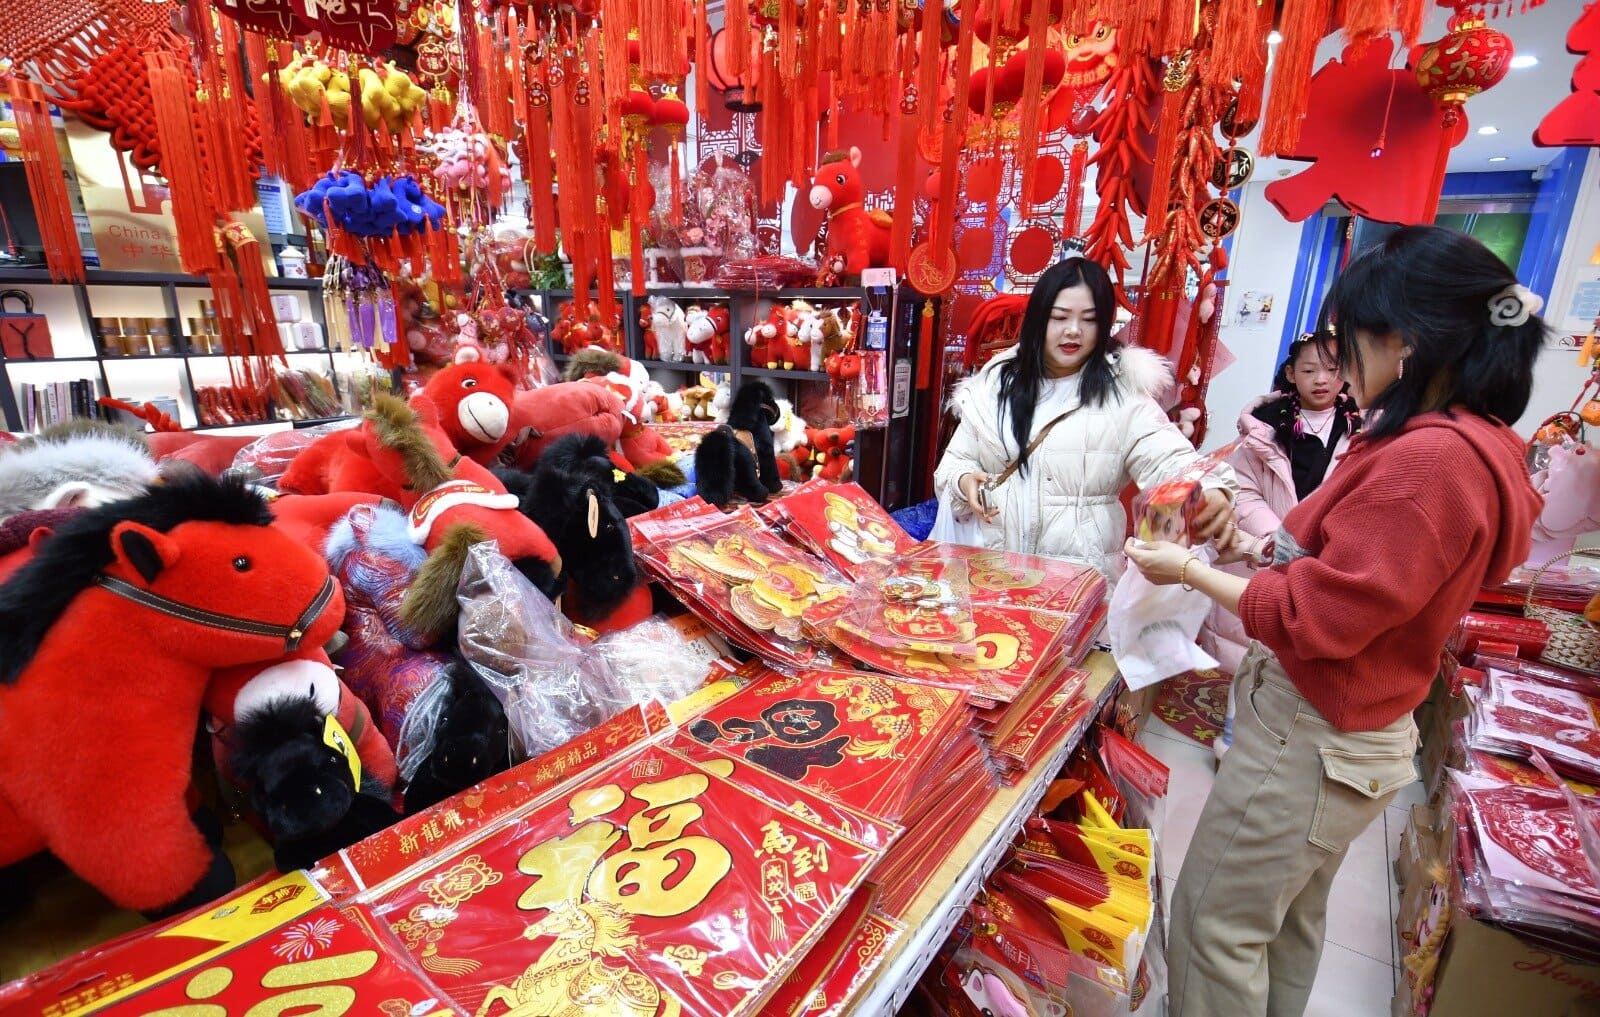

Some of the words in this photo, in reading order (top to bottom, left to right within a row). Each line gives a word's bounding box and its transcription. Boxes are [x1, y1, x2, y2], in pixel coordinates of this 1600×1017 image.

[108, 224, 160, 240] China
[399, 808, 465, 854] 新龍飛
[516, 772, 733, 917] 福
[443, 873, 476, 892] 福
